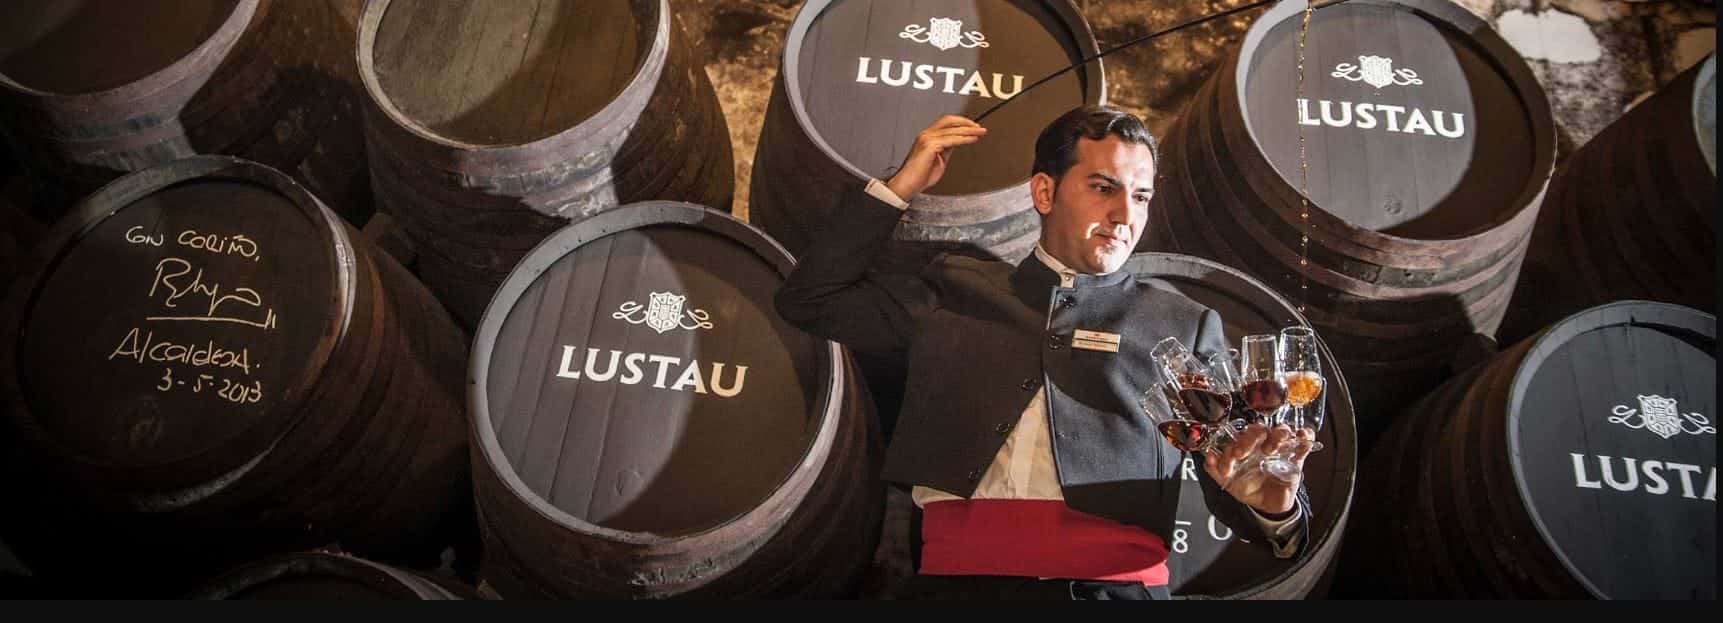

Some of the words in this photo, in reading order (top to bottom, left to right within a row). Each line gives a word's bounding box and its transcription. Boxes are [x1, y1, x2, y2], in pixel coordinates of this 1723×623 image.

[856, 57, 1024, 100] LUSTAU
[1297, 98, 1465, 138] LUSTAU
[556, 345, 748, 397] LUSTAU
